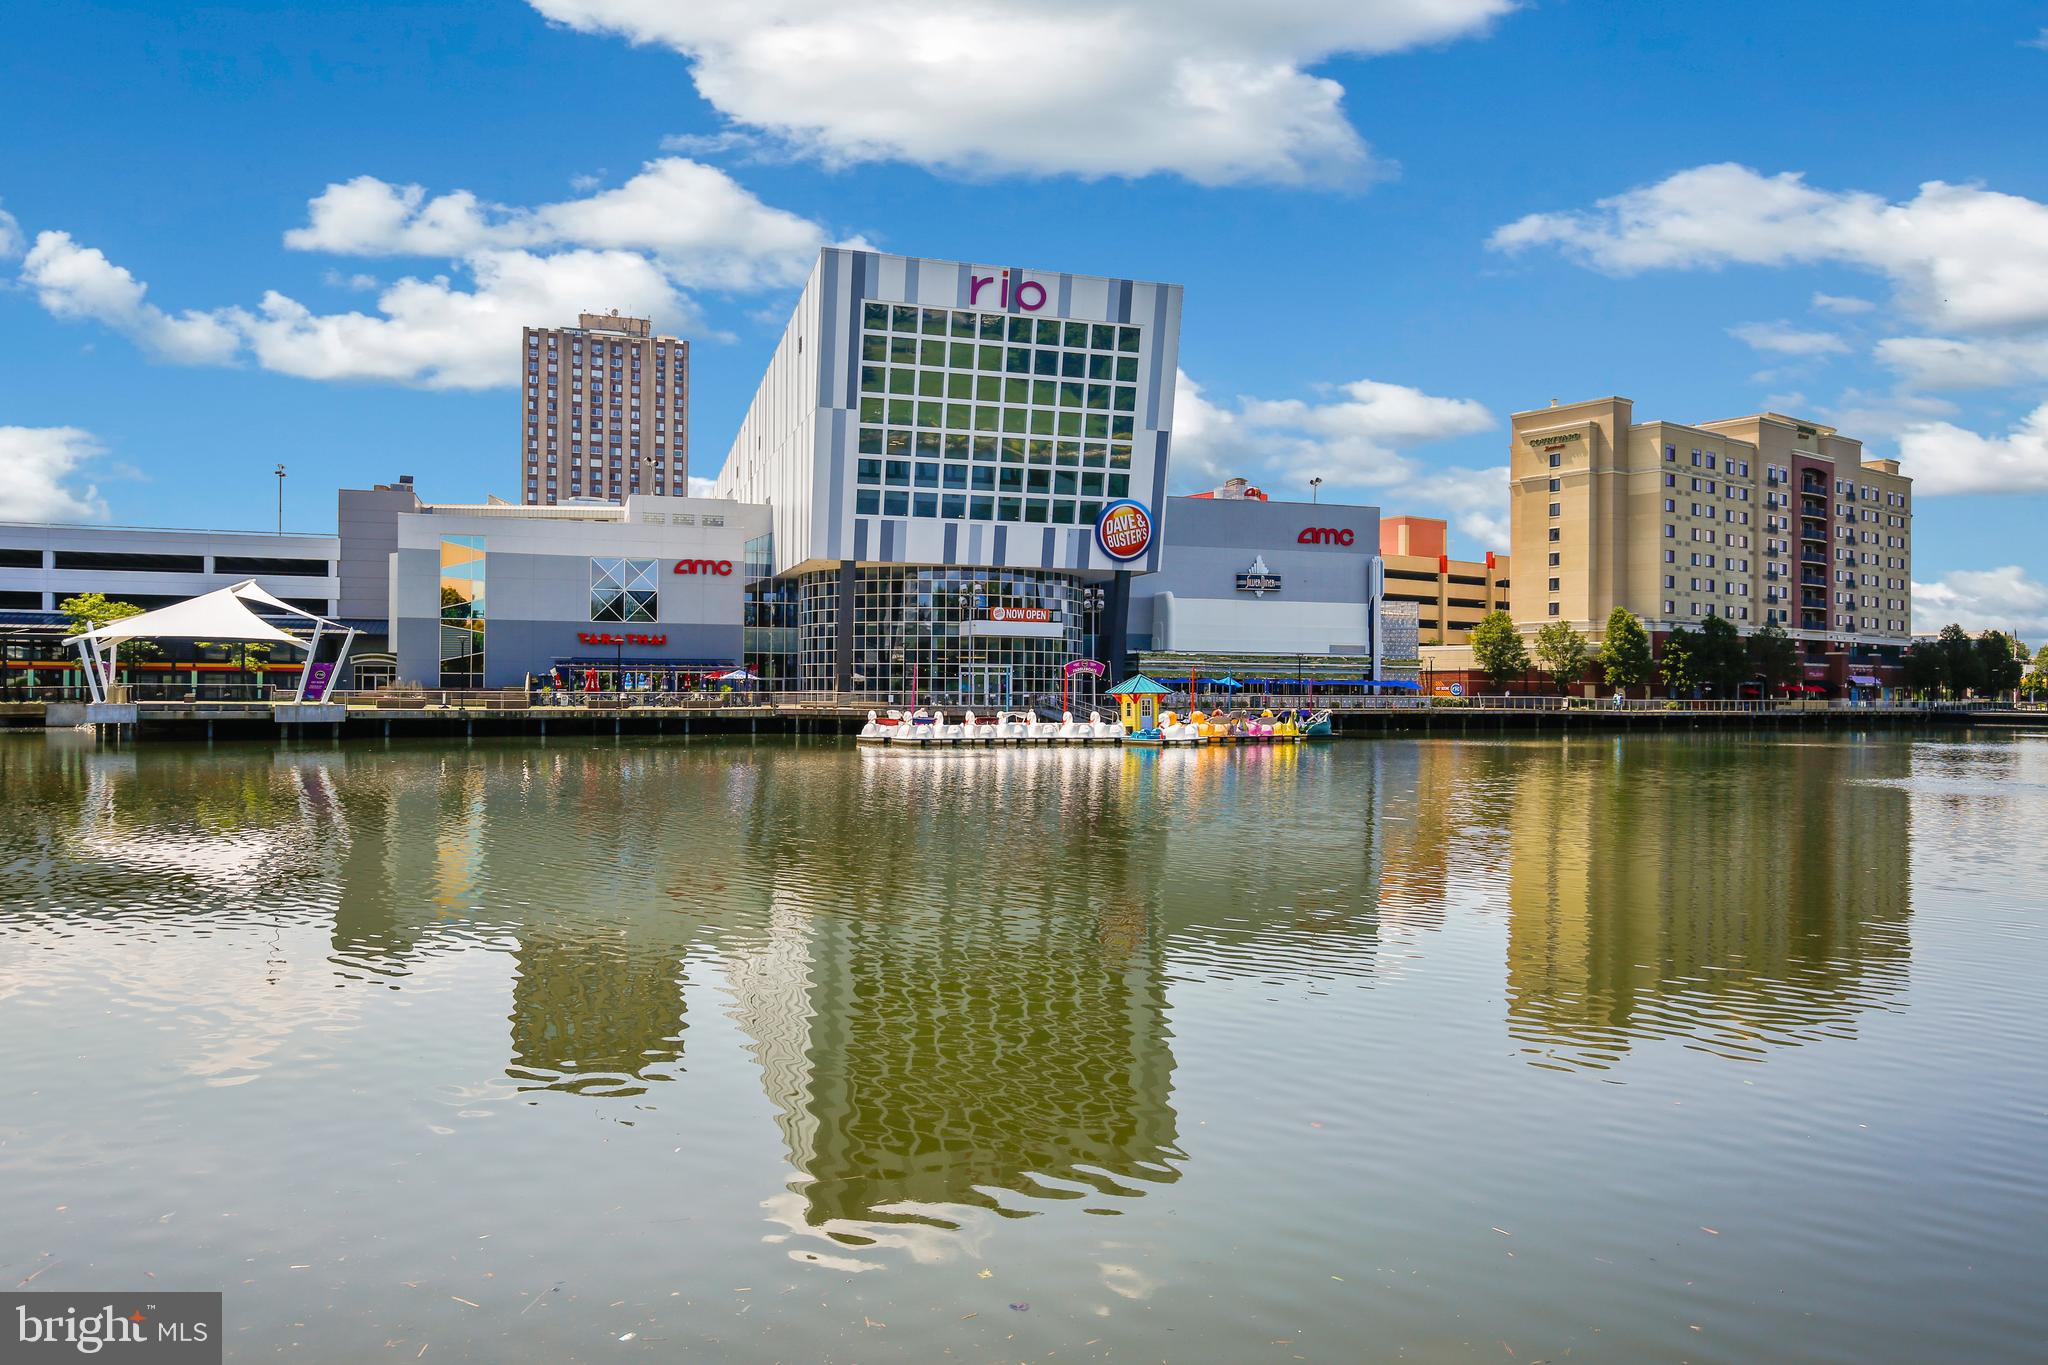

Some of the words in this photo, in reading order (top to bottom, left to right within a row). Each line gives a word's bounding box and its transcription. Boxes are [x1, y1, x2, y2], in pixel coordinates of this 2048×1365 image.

[970, 270, 1047, 311] rio
[1106, 514, 1136, 535] DAVE
[1136, 513, 1146, 528] &
[1107, 528, 1148, 548] BUSTER'S
[1006, 609, 1025, 619] NOW
[1026, 610, 1047, 620] OPEN
[625, 634, 667, 646] THAI
